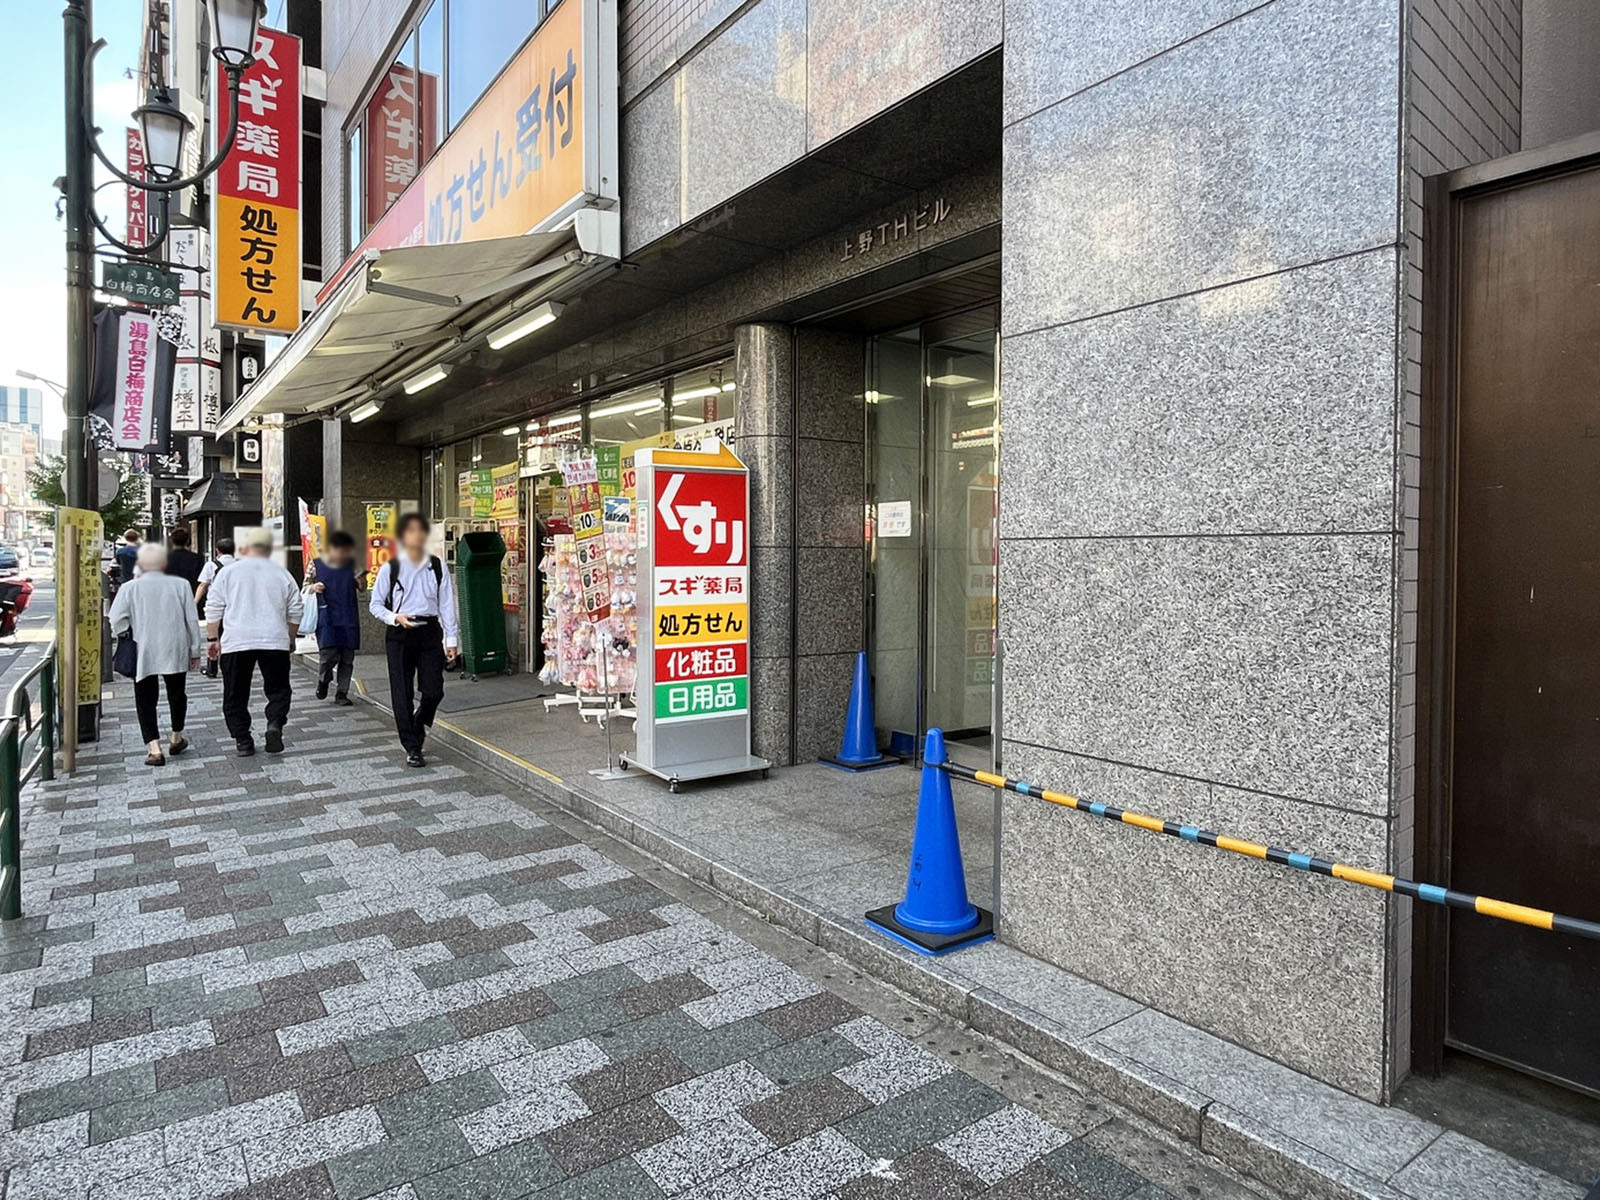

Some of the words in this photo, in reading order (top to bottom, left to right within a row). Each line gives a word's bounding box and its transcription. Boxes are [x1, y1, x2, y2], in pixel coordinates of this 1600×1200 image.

[236, 34, 282, 200] スギ薬局
[426, 48, 577, 244] 処方せん受付
[839, 197, 952, 263] 上野THビル
[105, 279, 176, 299] 白梅商店会
[240, 205, 279, 324] 処方せん
[122, 320, 149, 441] 湯島白梅商店会
[657, 474, 743, 564] くすり
[658, 575, 743, 596] スギ薬局
[658, 611, 743, 637] 処方せん
[666, 647, 737, 679] 化粧品
[668, 682, 737, 713] 日用品
